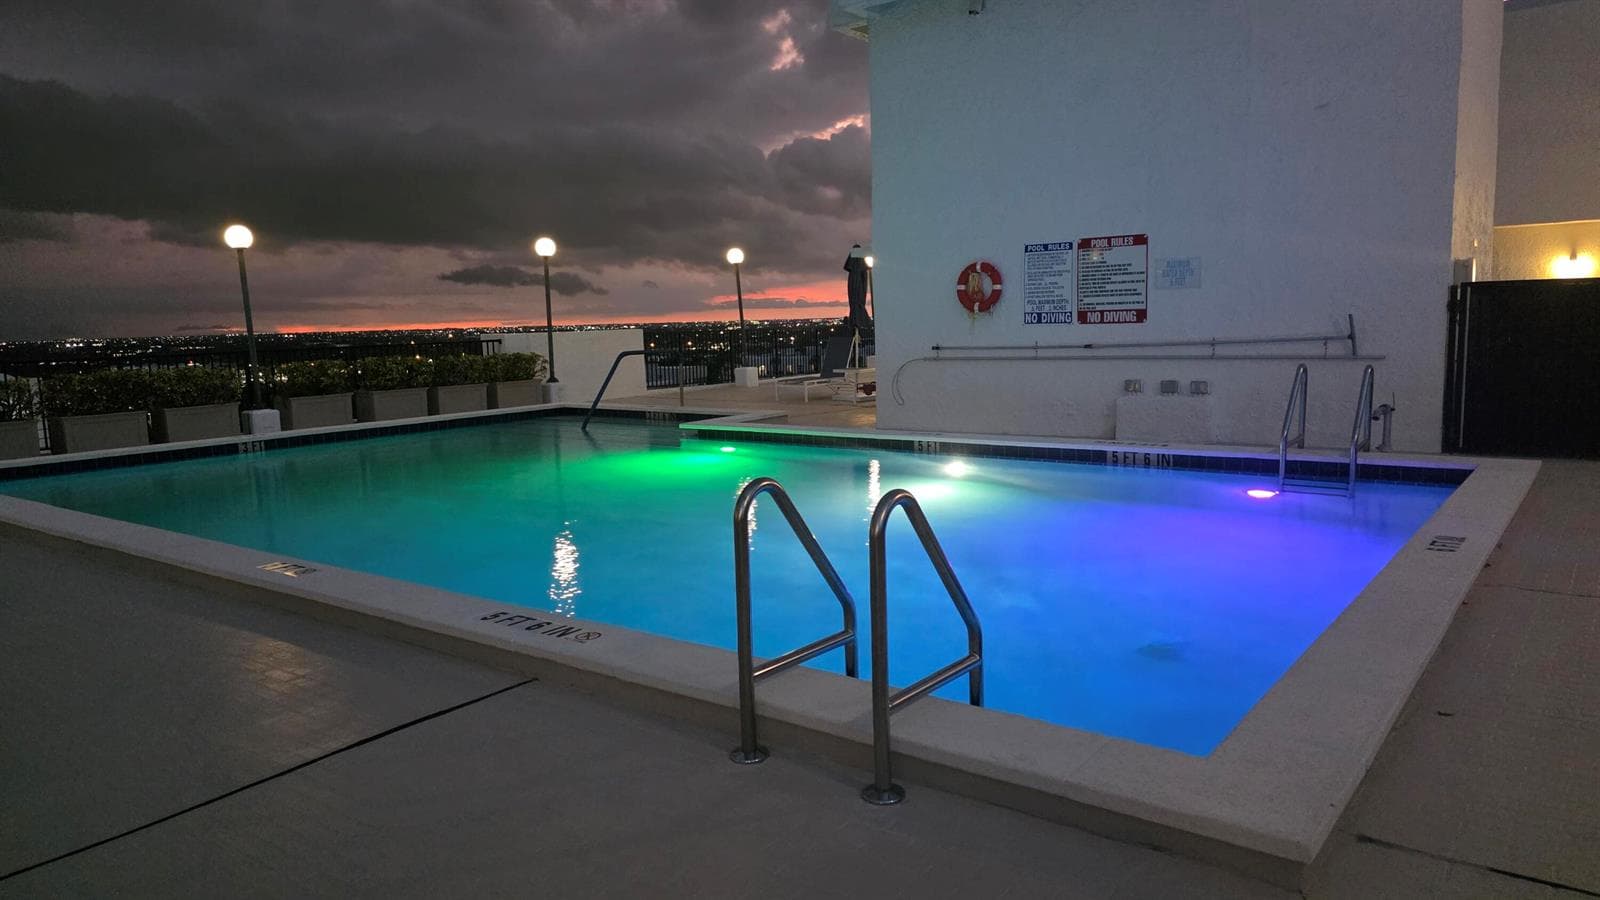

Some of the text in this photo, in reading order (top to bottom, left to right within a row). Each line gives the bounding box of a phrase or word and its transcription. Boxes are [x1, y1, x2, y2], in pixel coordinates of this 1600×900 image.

[1047, 243, 1070, 251] RULES
[1091, 237, 1134, 248] POOL RULES
[1025, 312, 1072, 323] NO DIVING
[1087, 311, 1137, 323] NO DIVING
[1112, 451, 1171, 467] 5 FT 6 IN
[480, 612, 582, 638] 5 FT 6 IN
